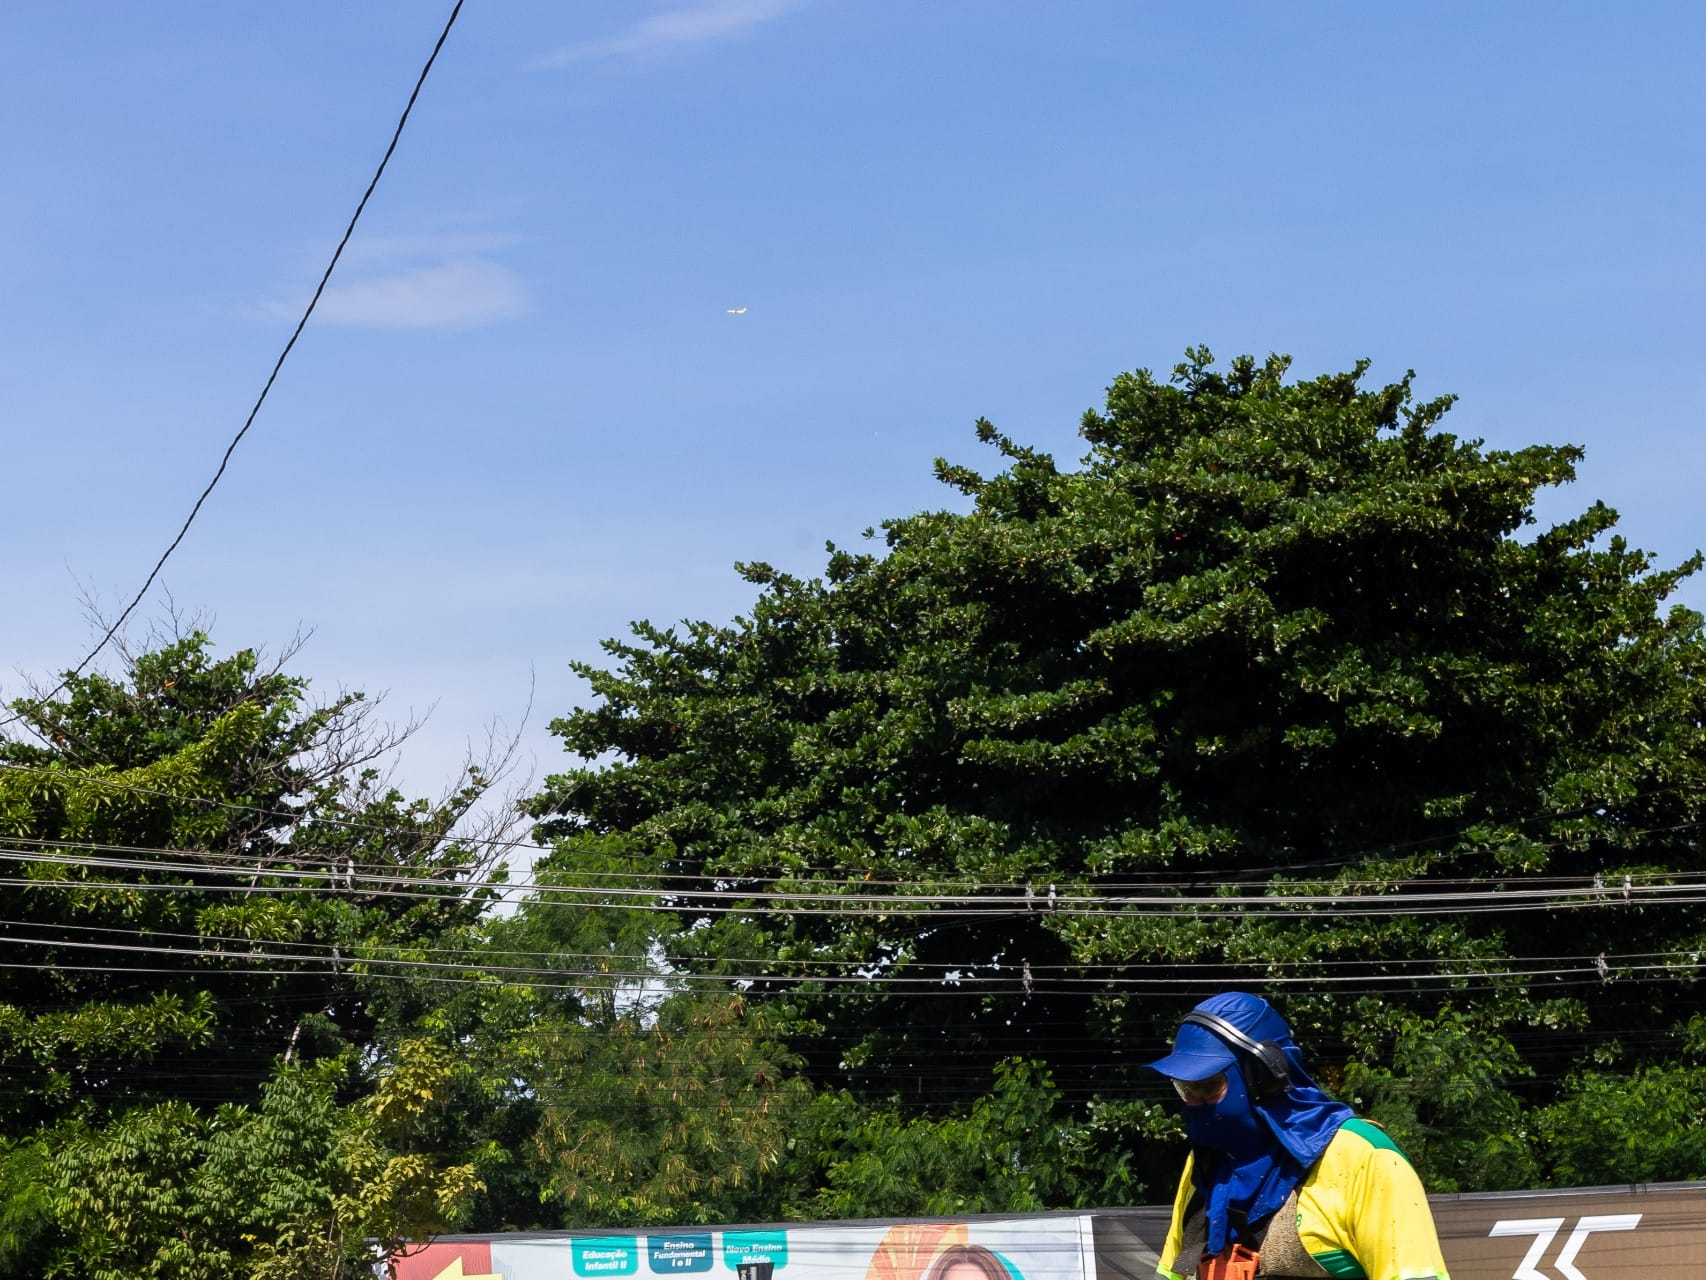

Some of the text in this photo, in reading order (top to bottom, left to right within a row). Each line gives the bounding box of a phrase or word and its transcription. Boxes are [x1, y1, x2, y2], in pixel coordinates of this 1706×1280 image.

[663, 1241, 695, 1250] Ensino
[726, 1243, 783, 1254] Novo Ensino
[582, 1249, 628, 1260] Educação
[653, 1250, 706, 1260] Fundamental
[584, 1261, 619, 1271] Infantil
